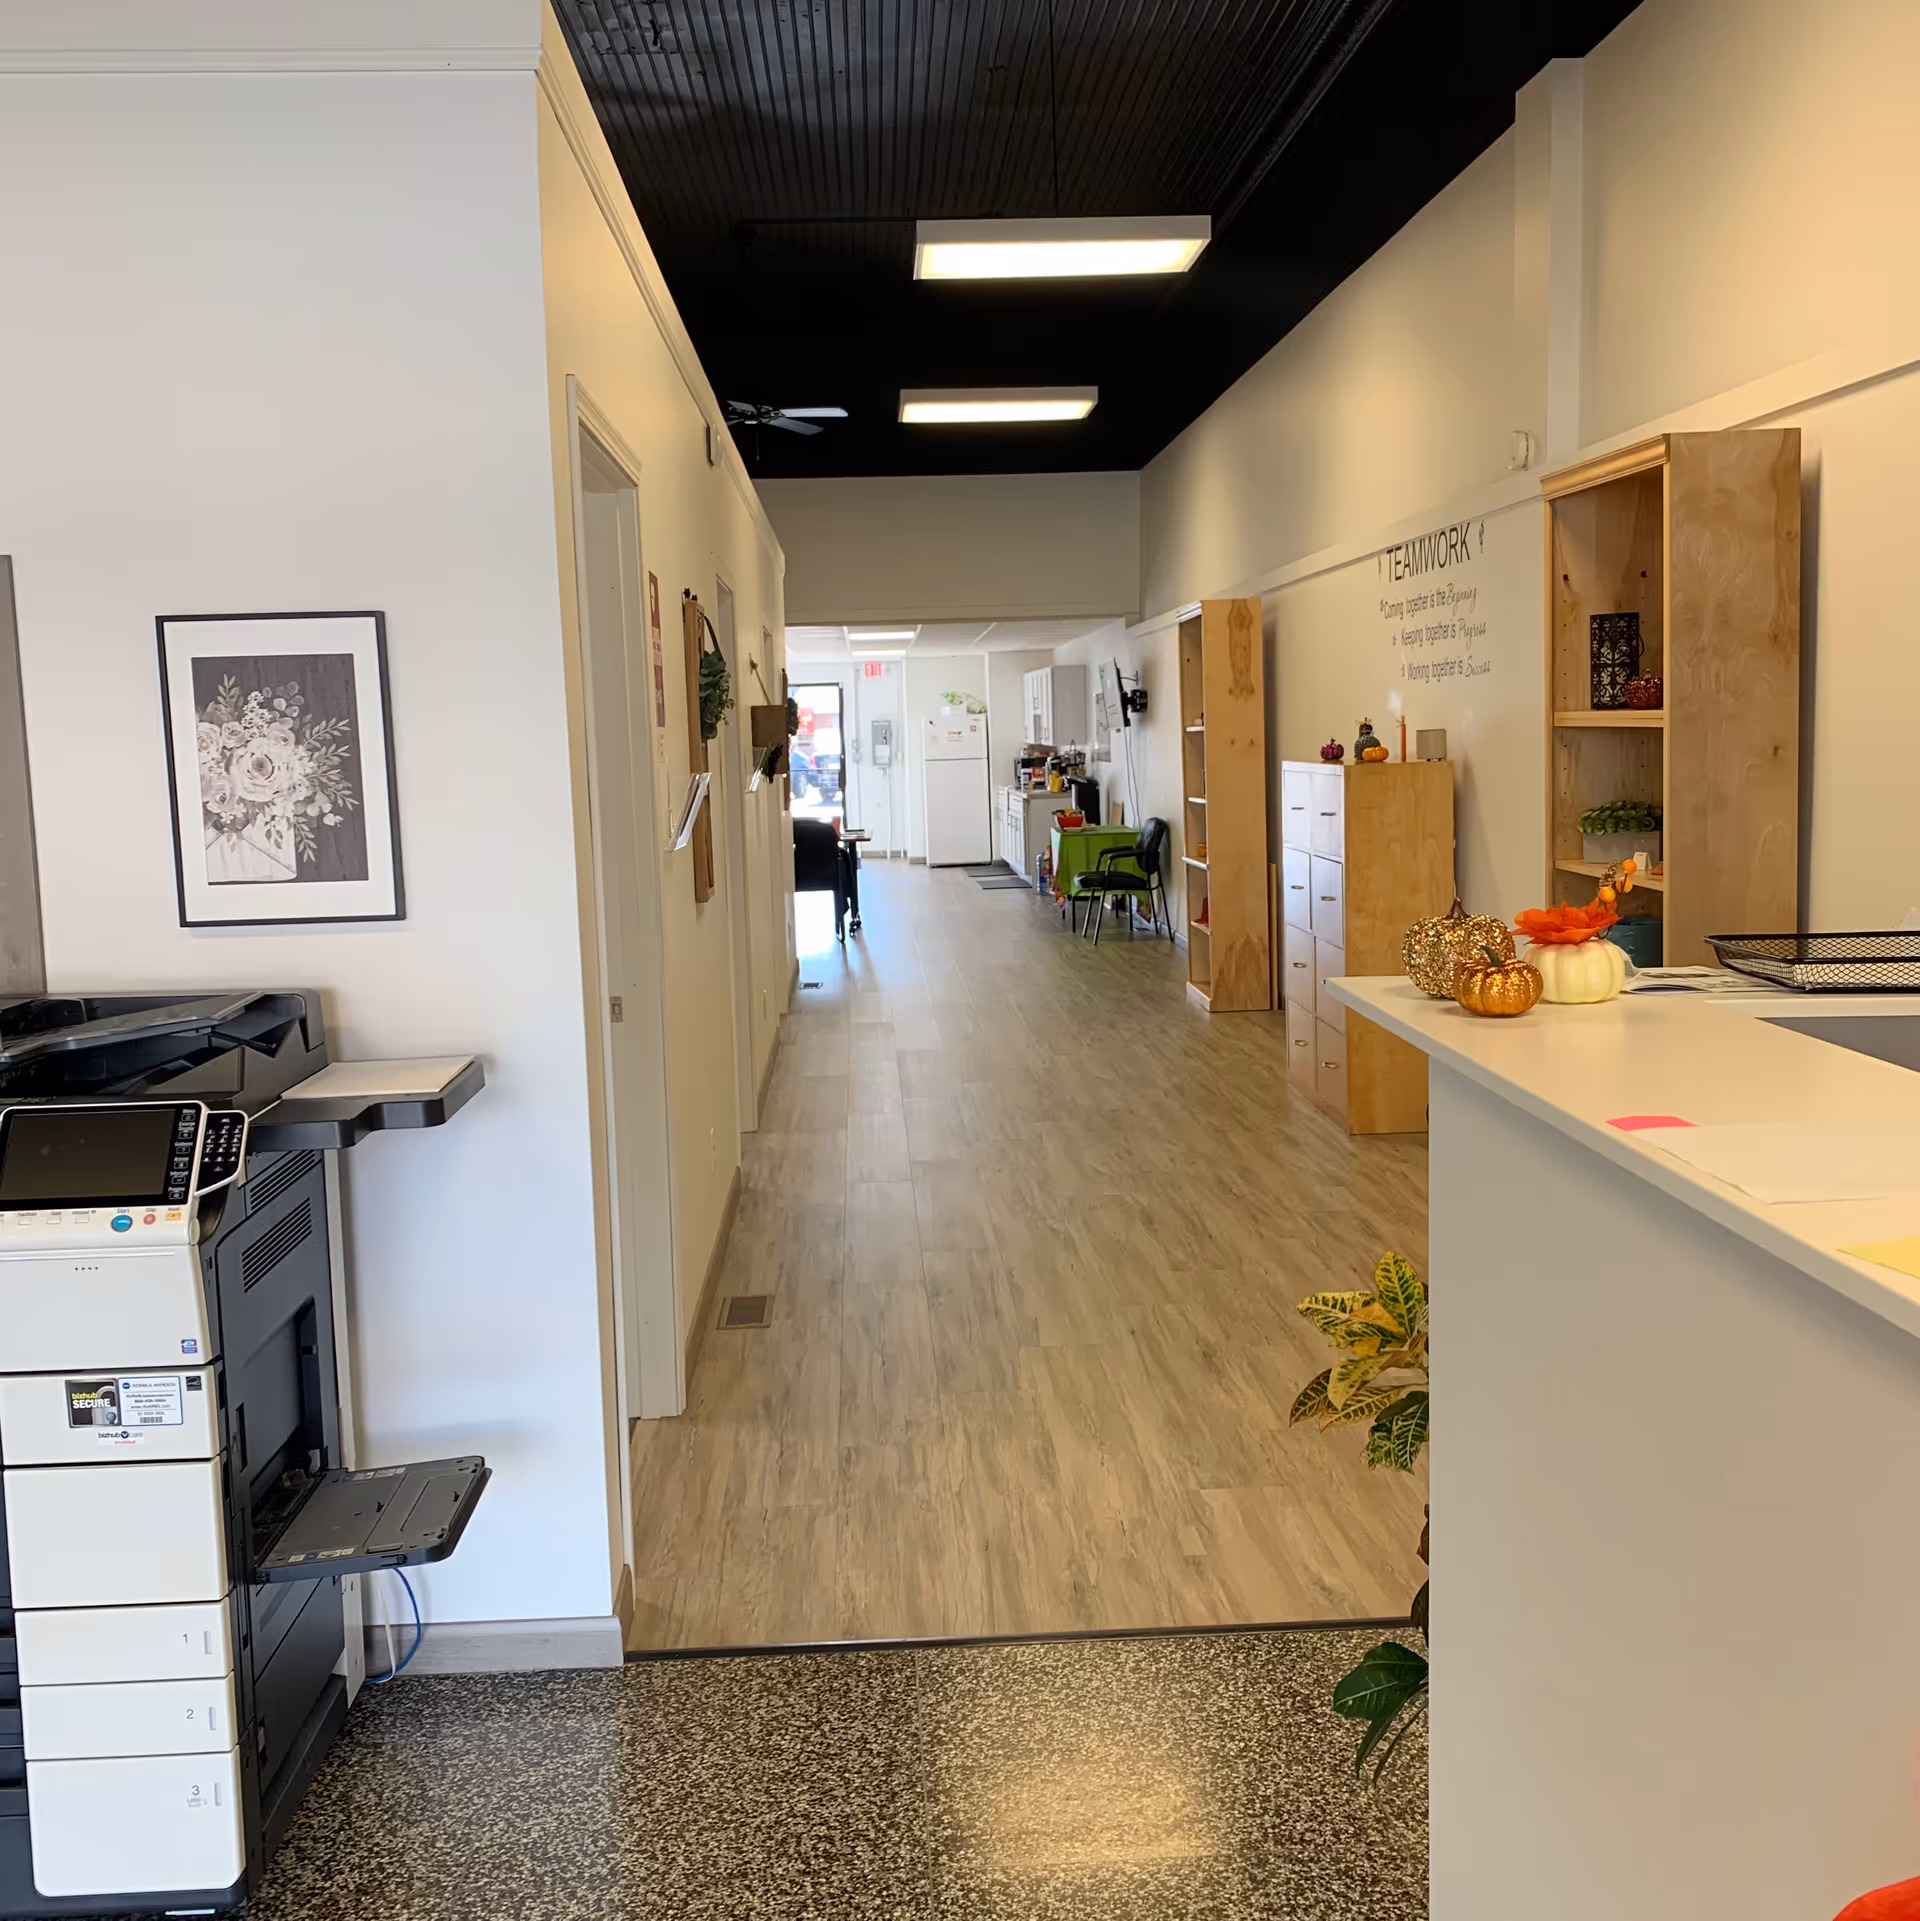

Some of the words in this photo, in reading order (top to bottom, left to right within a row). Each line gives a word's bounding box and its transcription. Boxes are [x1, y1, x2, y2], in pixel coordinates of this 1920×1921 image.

[1386, 521, 1471, 583] TEAMWORK
[1384, 600, 1404, 620] Coming
[1405, 592, 1429, 617] together
[1436, 587, 1446, 606] the
[1401, 628, 1424, 649] Keeping
[1425, 621, 1449, 645] together
[1457, 618, 1487, 651] Progress
[864, 663, 882, 678] EXIT
[1407, 661, 1430, 683] Working
[1431, 658, 1456, 683] together
[1464, 655, 1491, 677] Success
[72, 1398, 111, 1409] SECURE
[182, 1633, 188, 1644] 1
[186, 1709, 195, 1720] 2
[191, 1784, 200, 1796] 3
